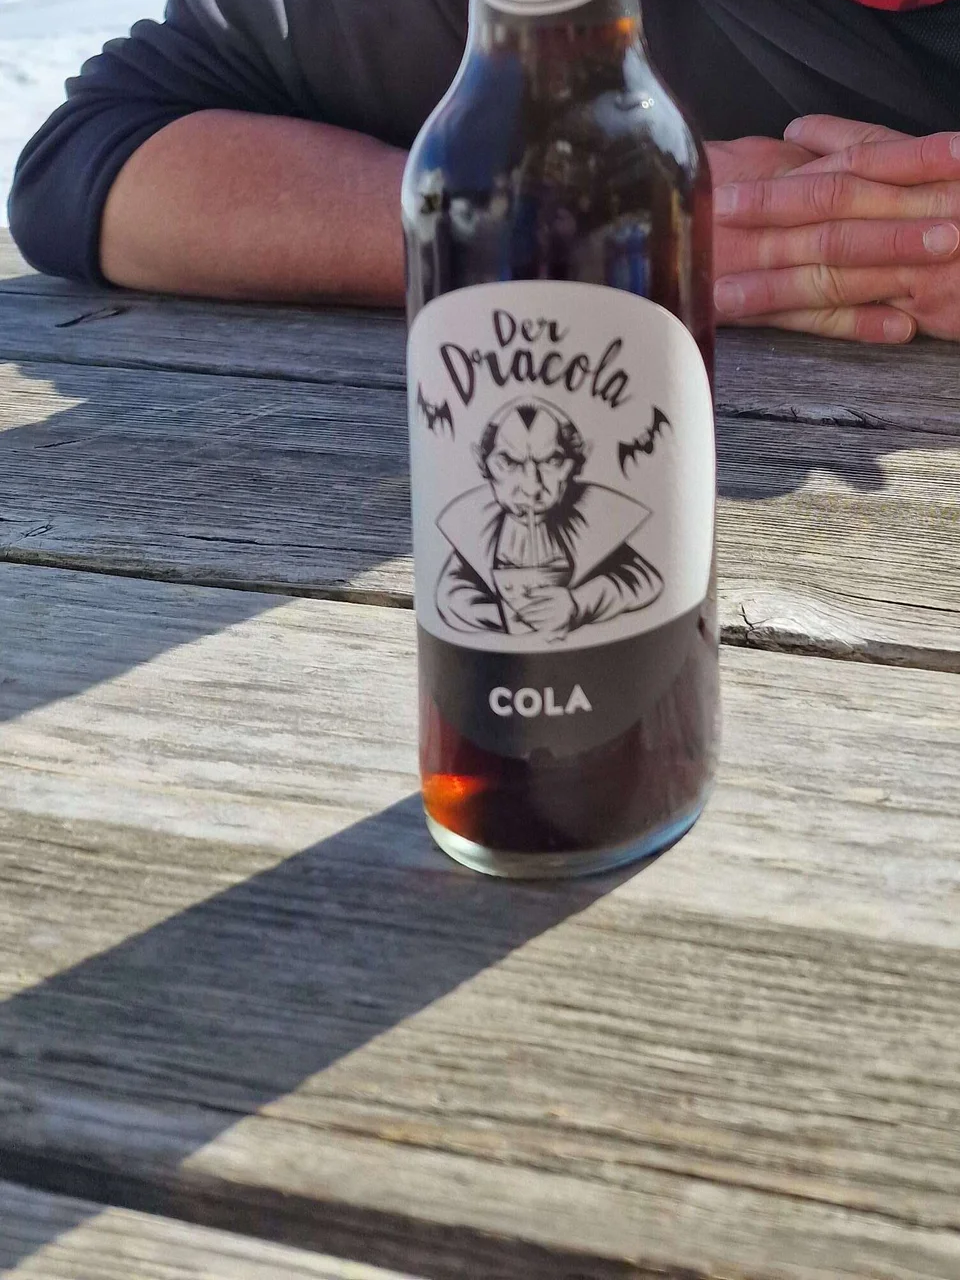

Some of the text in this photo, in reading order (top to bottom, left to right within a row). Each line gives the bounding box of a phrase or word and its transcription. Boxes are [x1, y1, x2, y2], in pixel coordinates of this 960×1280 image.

[492, 308, 570, 347] Der
[440, 337, 632, 408] Dracola
[488, 684, 593, 718] COLA
